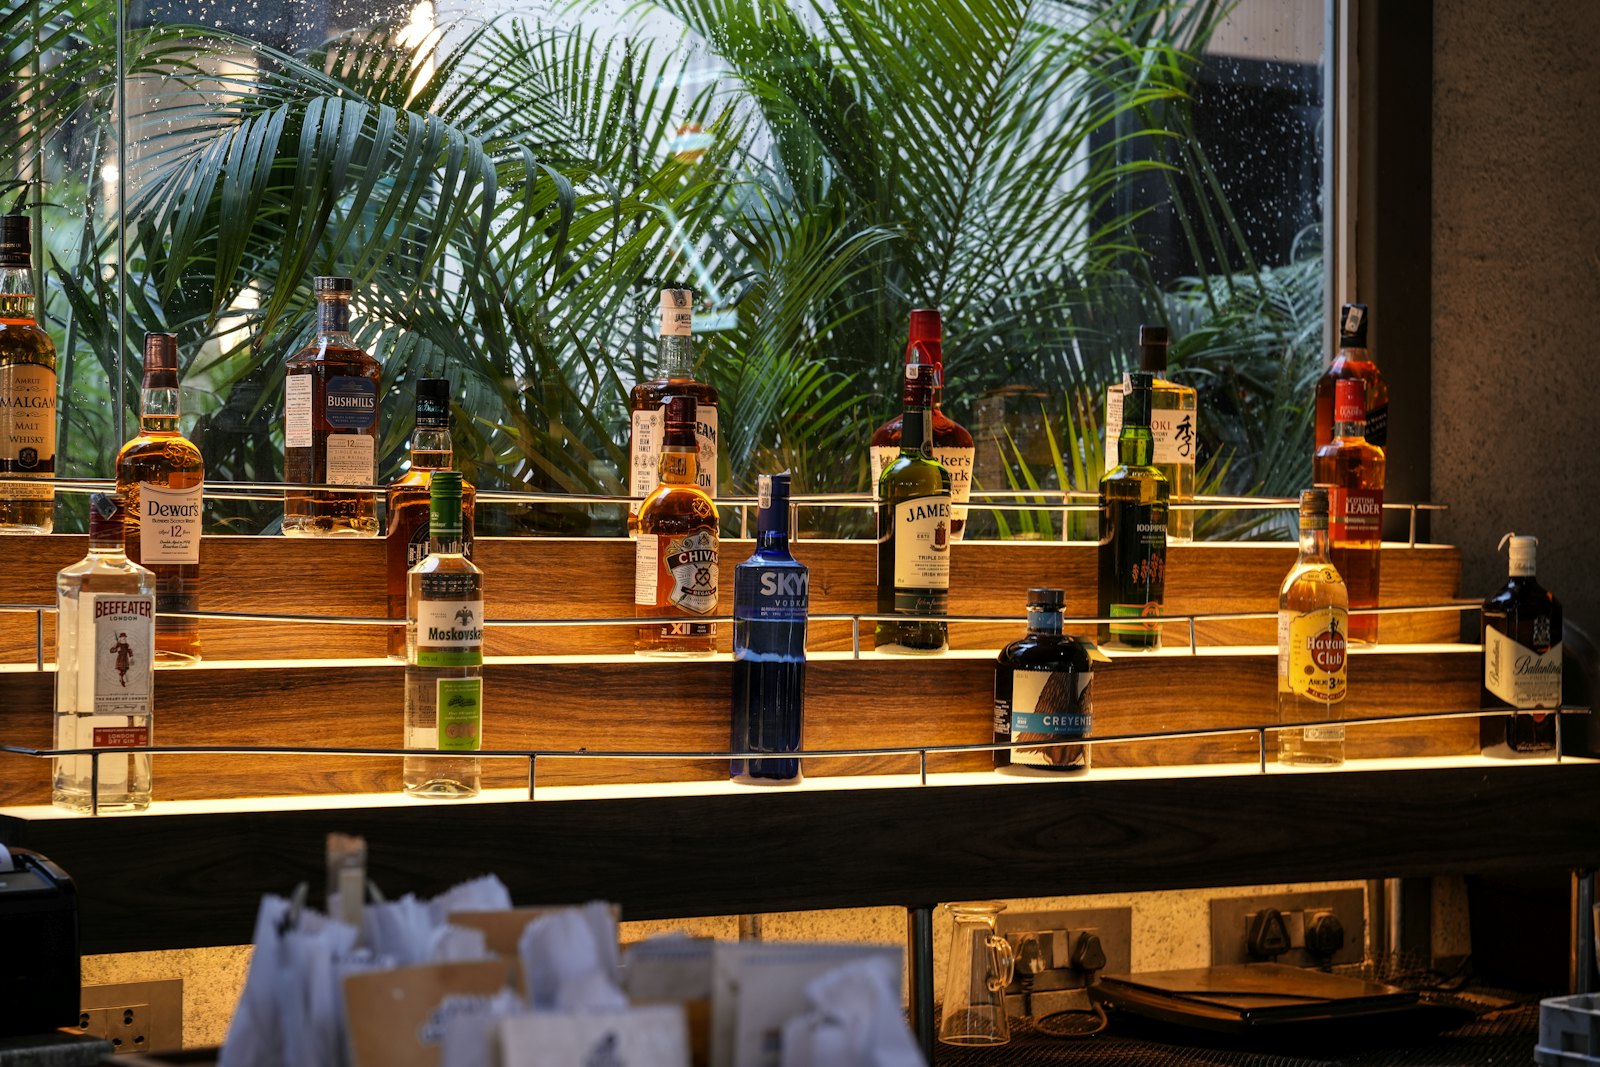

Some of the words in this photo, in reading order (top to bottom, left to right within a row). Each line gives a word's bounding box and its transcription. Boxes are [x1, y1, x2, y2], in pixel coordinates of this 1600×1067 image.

[0, 396, 55, 408] MALGAM
[327, 395, 374, 408] BUSHMILLS
[15, 422, 39, 430] MALT
[1151, 420, 1171, 430] OKI
[9, 435, 44, 444] WHISKY
[696, 421, 716, 446] EAM
[935, 455, 971, 467] ker's
[147, 501, 199, 517] Dewar's
[906, 503, 949, 522] JAMES
[1345, 503, 1380, 515] LEADER
[170, 525, 182, 537] 12
[678, 551, 719, 564] CHIVAS
[760, 571, 808, 596] SKYY
[95, 600, 152, 619] BEEFEATER
[428, 626, 482, 641] Moskovska
[1306, 635, 1347, 650] Havan
[1317, 651, 1342, 665] Club
[1328, 677, 1336, 690] 3
[1042, 715, 1092, 727] CREYENTE
